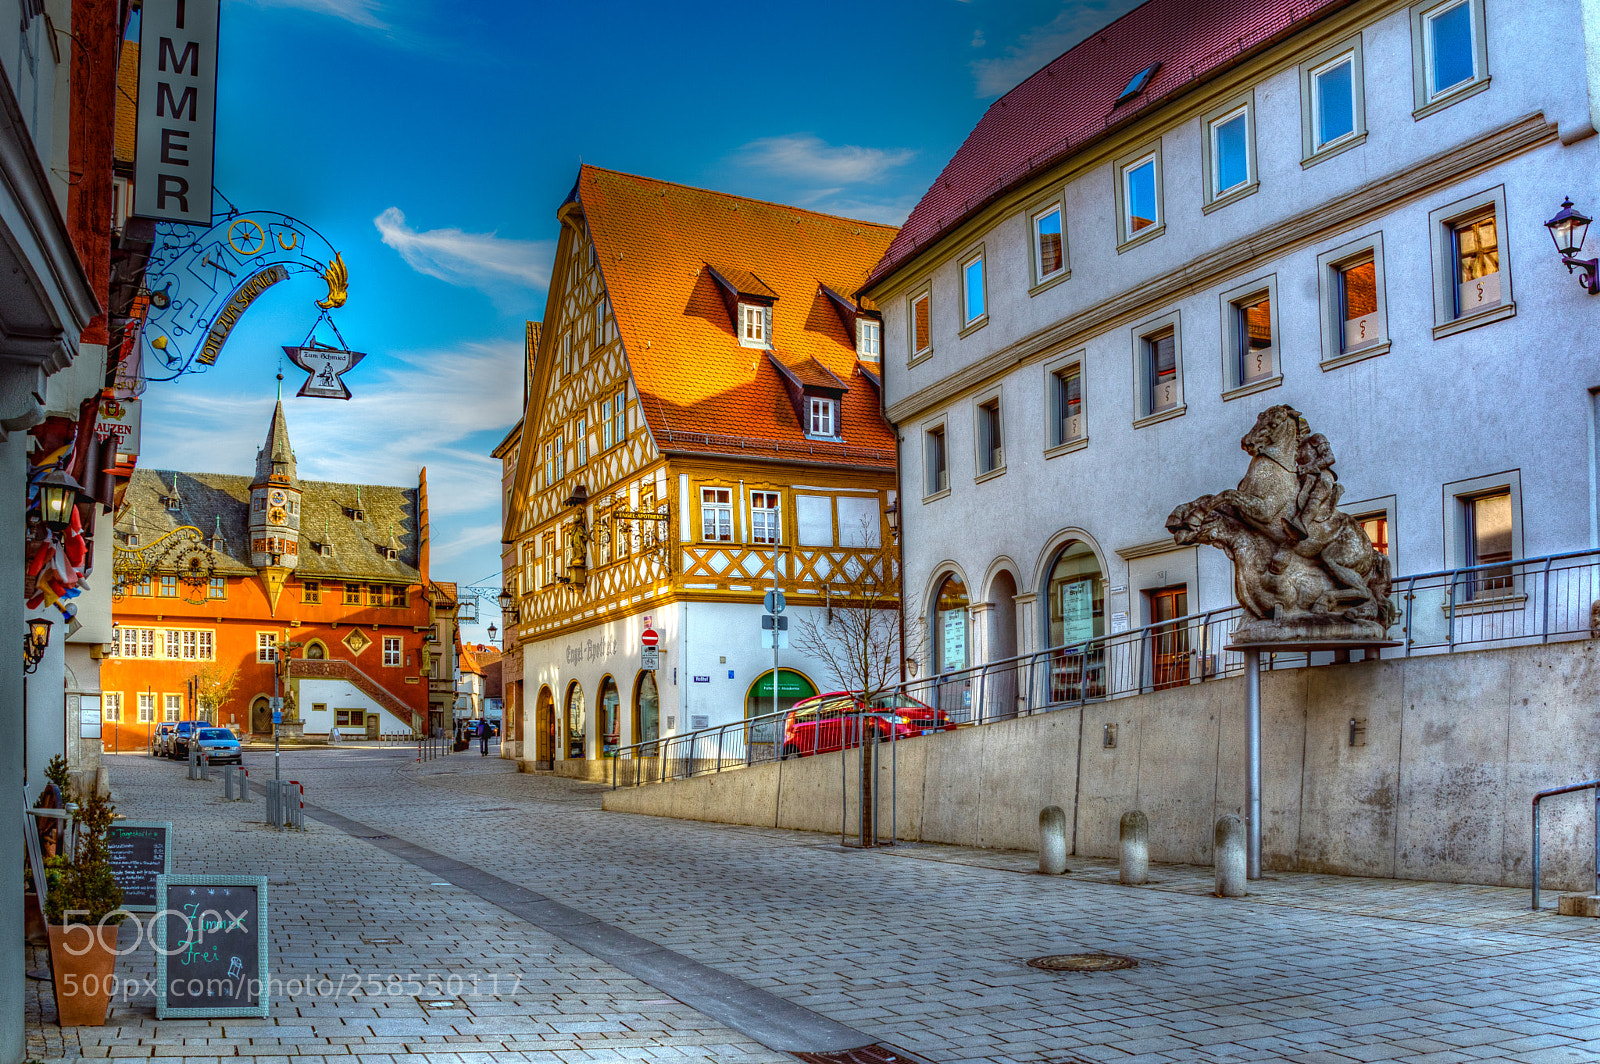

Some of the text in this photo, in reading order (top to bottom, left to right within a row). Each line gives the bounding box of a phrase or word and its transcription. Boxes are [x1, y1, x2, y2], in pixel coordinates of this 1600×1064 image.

[199, 269, 279, 364] HOTEL ZUM SCHMIED
[320, 353, 346, 361] Schmied
[98, 433, 125, 445] BRU
